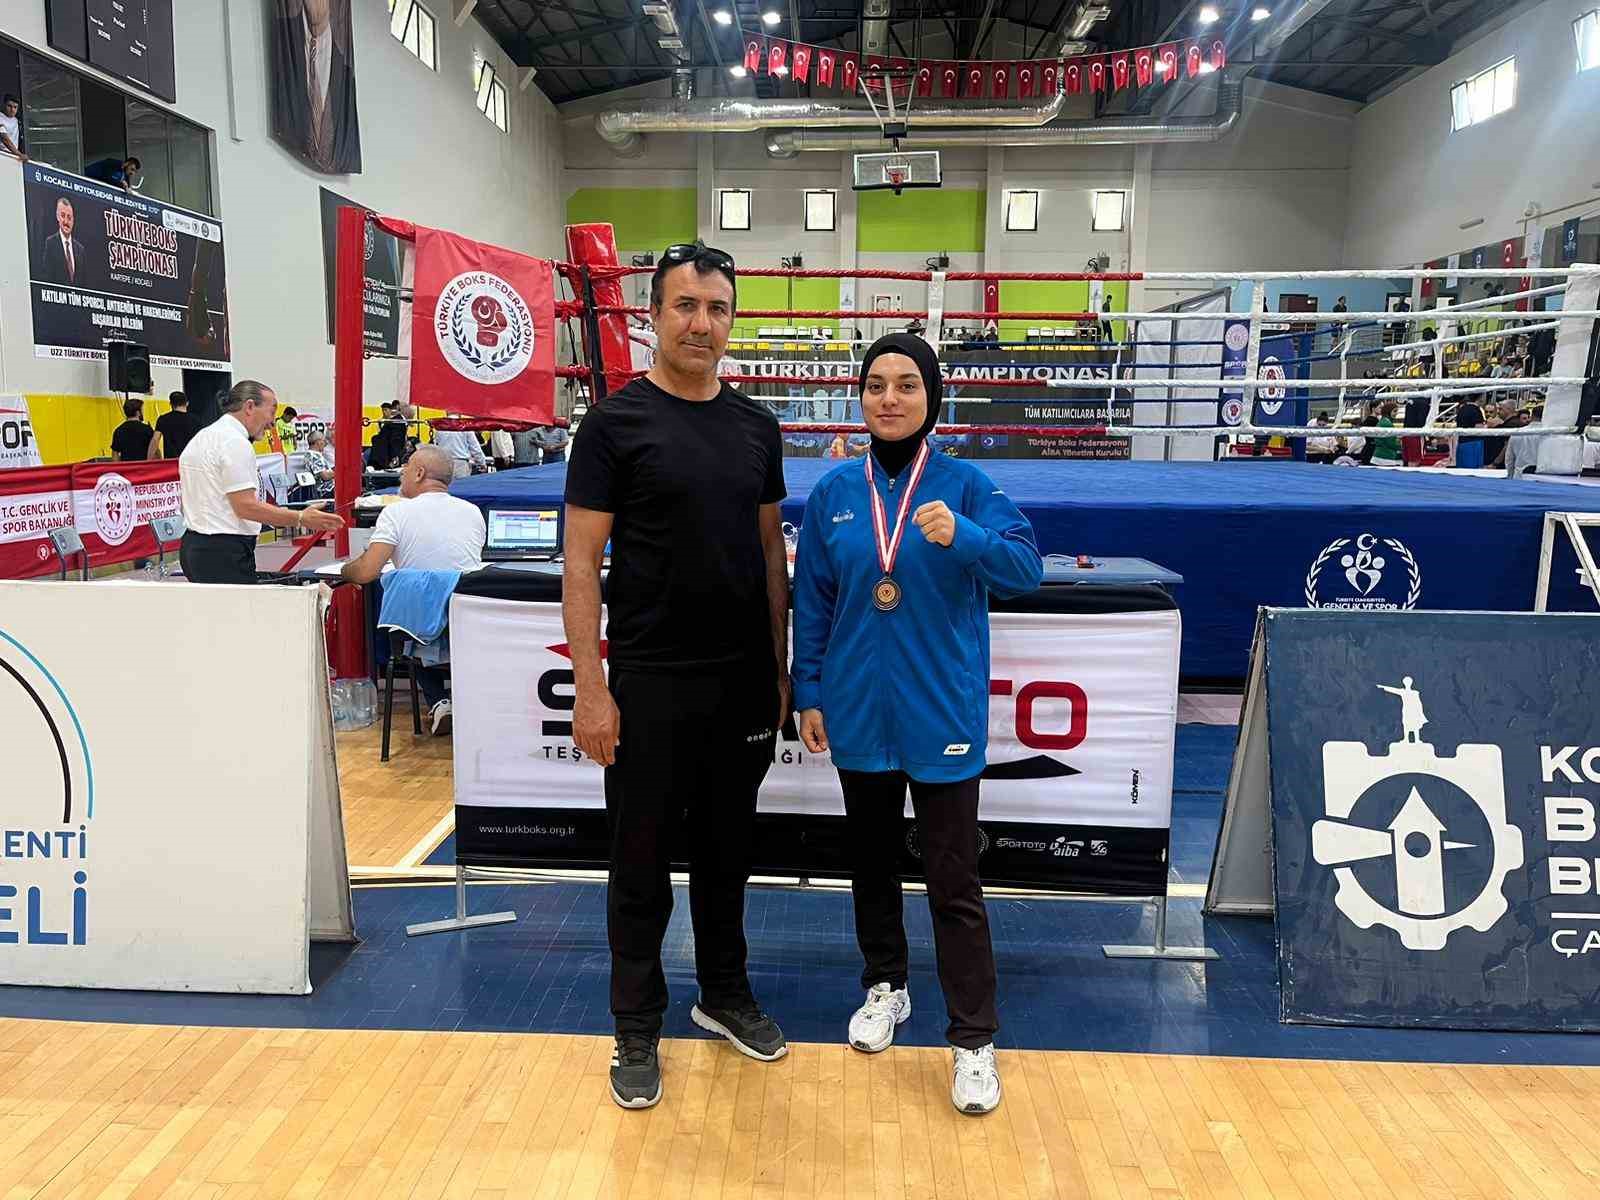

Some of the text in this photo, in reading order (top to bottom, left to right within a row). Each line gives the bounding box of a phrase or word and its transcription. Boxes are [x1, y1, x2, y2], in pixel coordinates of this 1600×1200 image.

[103, 208, 151, 245] TÜRKİYE
[149, 223, 178, 253] BOKS
[108, 240, 179, 279] ŞAMPİYONASI
[41, 288, 68, 304] KATILAN
[68, 291, 81, 307] TÜM
[456, 274, 487, 290] BOKS
[488, 277, 533, 356] FEDERASYONU
[50, 348, 107, 360] U22 TÜRKİYE BOKS
[749, 356, 850, 378] TÜRKİYE
[1024, 404, 1041, 418] TÜM
[1041, 407, 1096, 419] KATILIMCILARA
[134, 484, 166, 496] REPUBLIC
[166, 483, 175, 493] OF
[1, 500, 69, 518] T.C. GENÇLİK VE
[136, 498, 166, 509] MINISTRY
[167, 496, 175, 506] OF
[2, 513, 75, 535] SPOR BAKANLIĞI
[136, 512, 152, 523] AND
[543, 746, 590, 762] TEŞ
[478, 824, 576, 838] www.turkboks.org.tr
[0, 824, 87, 859] ENTİ
[996, 838, 1047, 851] SPORTOTO
